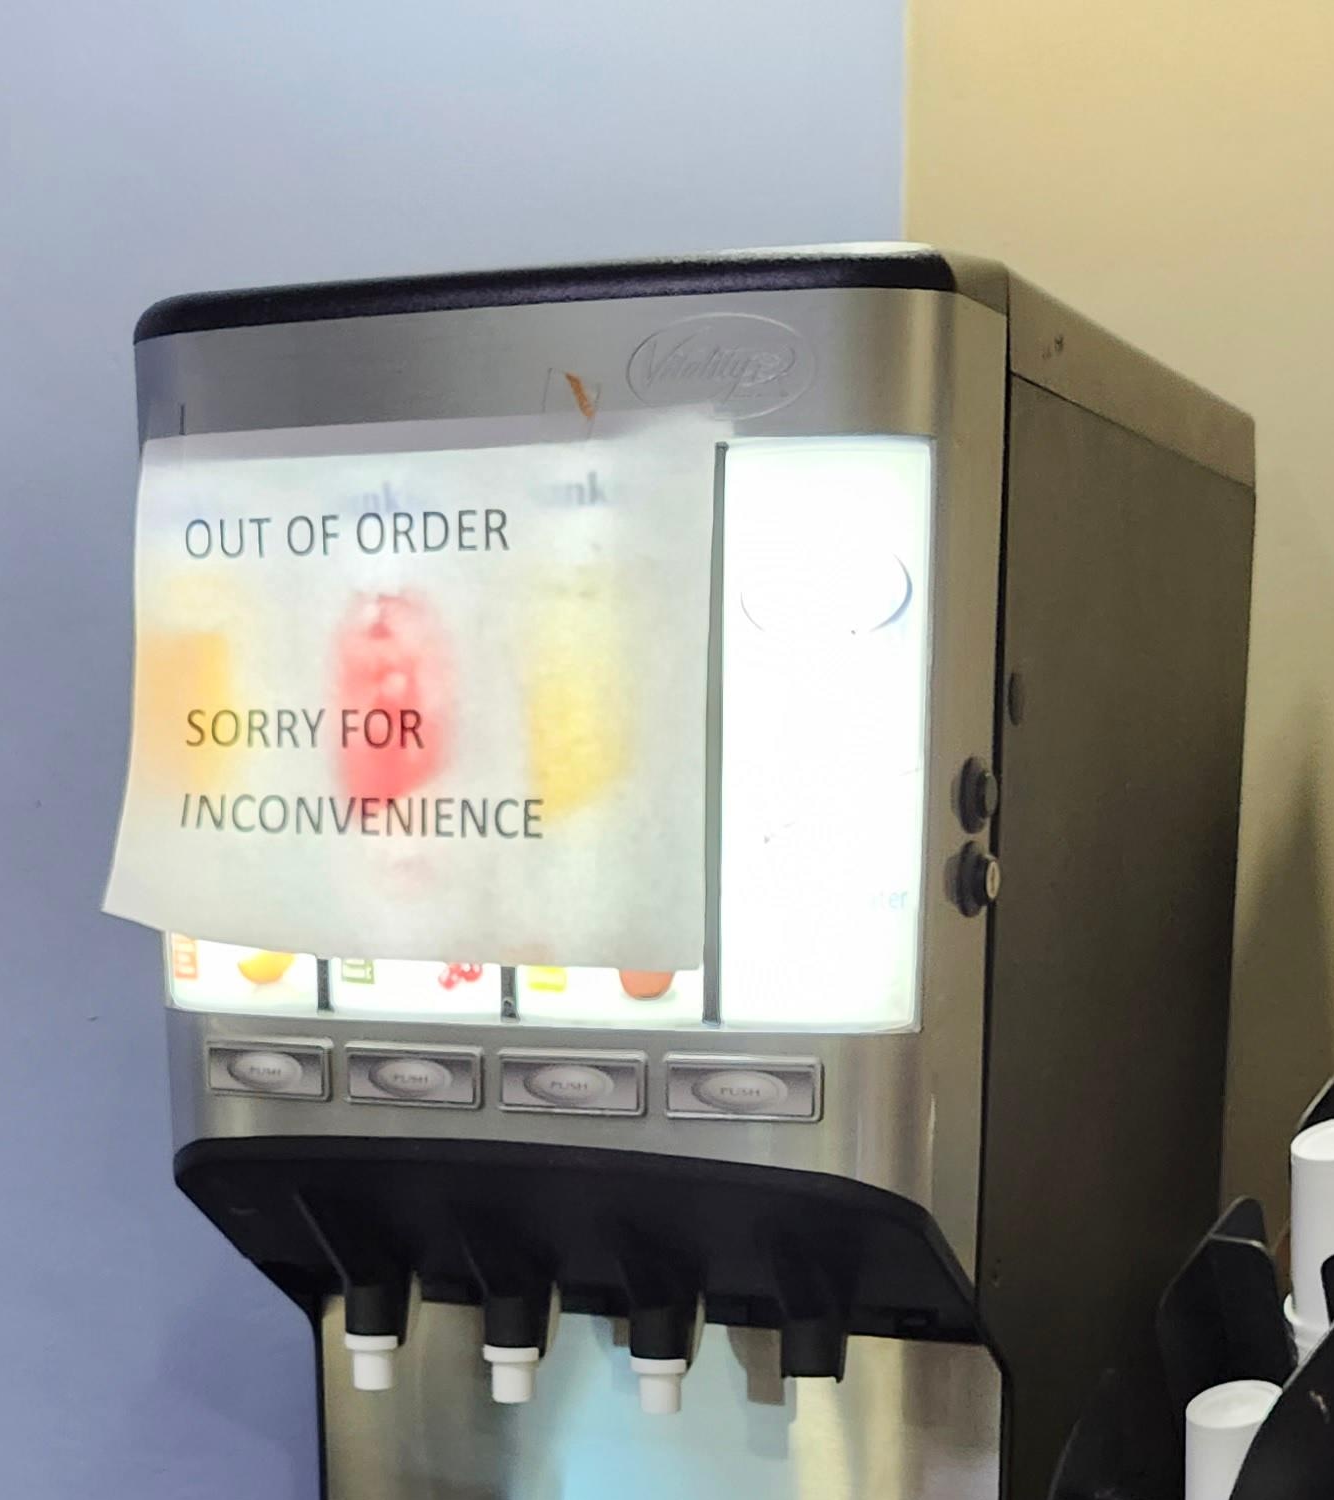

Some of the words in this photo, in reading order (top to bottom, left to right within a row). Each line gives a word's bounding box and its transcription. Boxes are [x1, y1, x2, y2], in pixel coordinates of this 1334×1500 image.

[183, 517, 272, 560] OUT
[286, 515, 341, 558] OF
[355, 508, 511, 555] ORDER
[184, 709, 326, 750] SORRY
[341, 709, 426, 750] FOR
[179, 793, 545, 840] INCONVENIENCE
[549, 1080, 588, 1090] PUSH
[719, 1086, 761, 1097] PUSH
